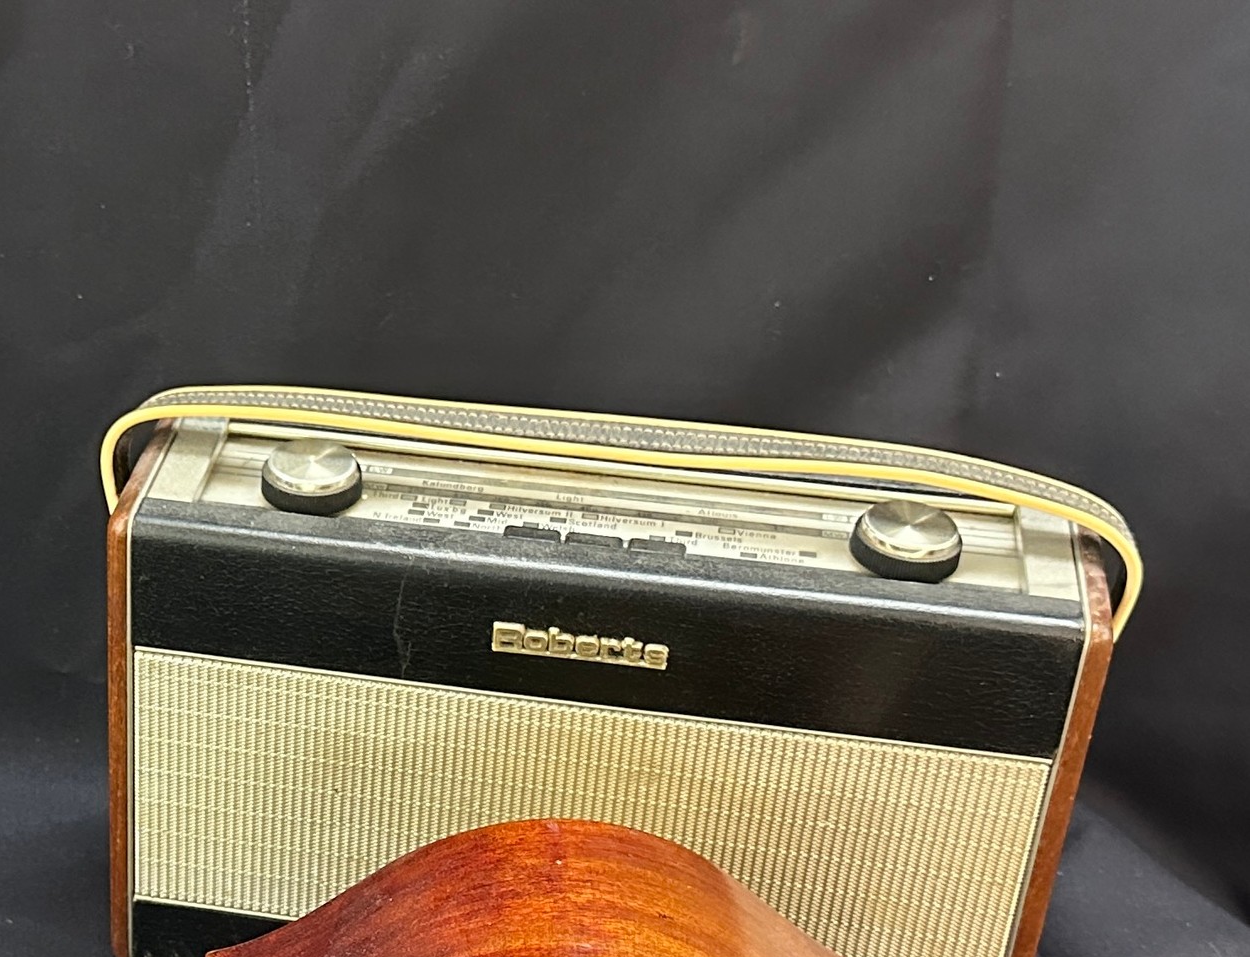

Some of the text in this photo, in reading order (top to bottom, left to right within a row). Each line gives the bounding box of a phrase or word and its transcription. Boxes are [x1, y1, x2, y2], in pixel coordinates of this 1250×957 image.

[421, 496, 449, 506] Light
[556, 493, 585, 503] Light
[426, 511, 454, 520] West
[495, 511, 523, 520] West
[506, 504, 562, 517] Hilversum
[569, 518, 618, 531] Scotland
[600, 516, 656, 527] Hilversum
[695, 532, 742, 543] Brussels
[735, 529, 777, 540] Vienna
[492, 621, 670, 671] Roberts
